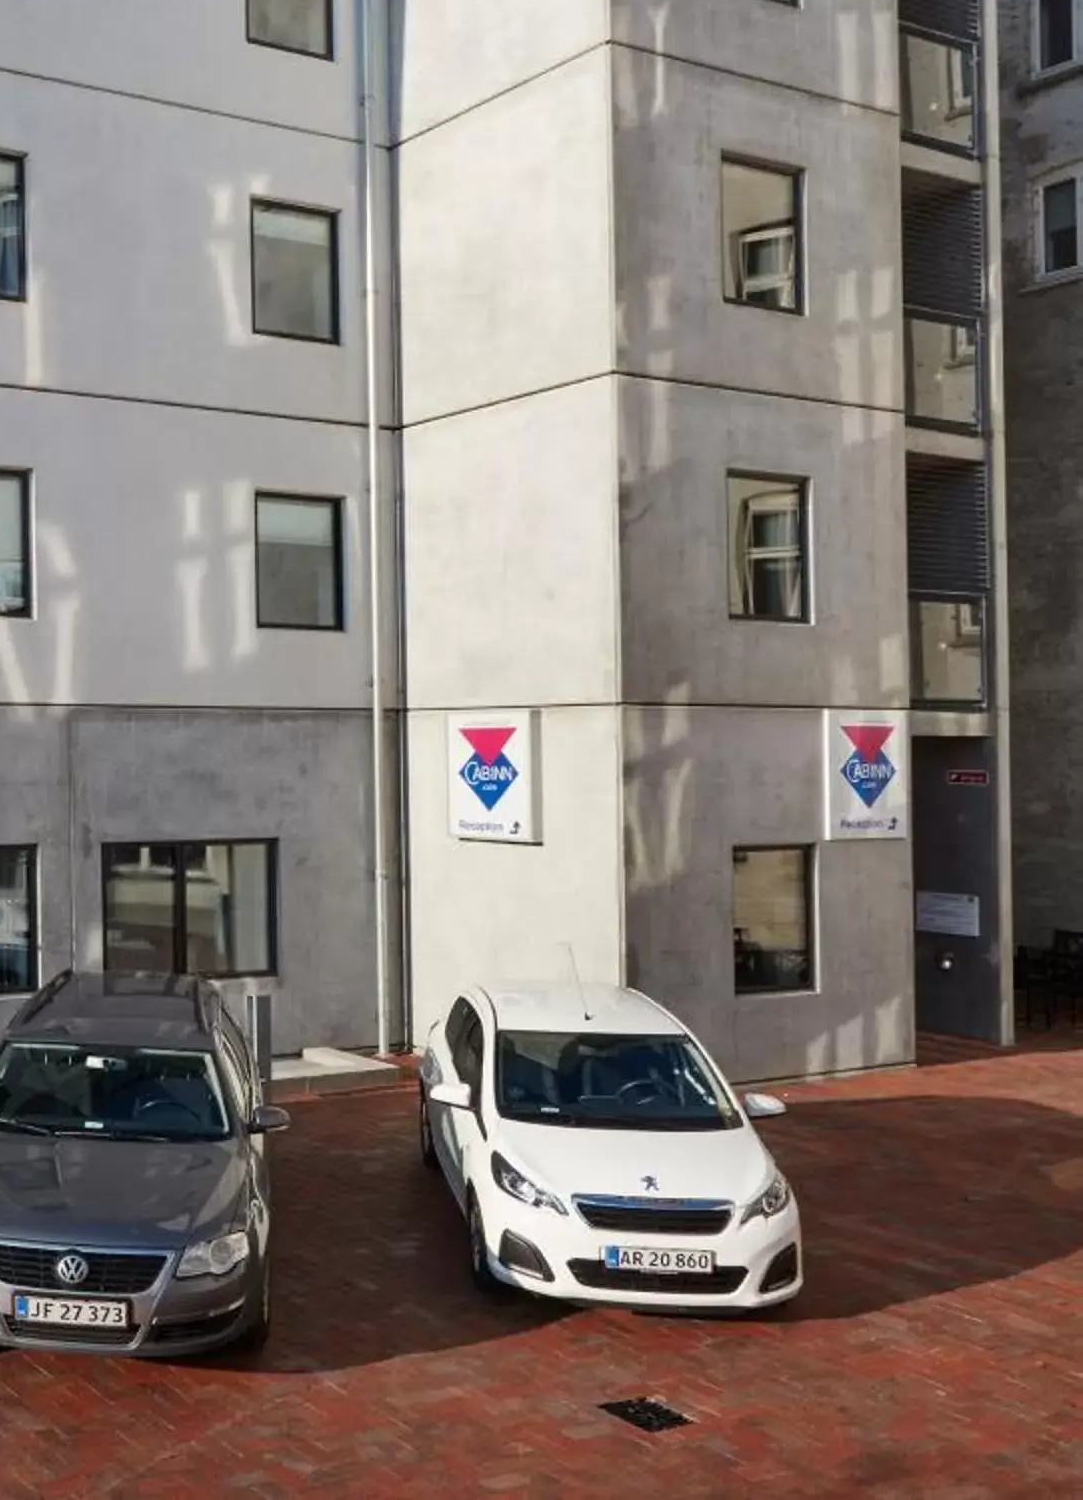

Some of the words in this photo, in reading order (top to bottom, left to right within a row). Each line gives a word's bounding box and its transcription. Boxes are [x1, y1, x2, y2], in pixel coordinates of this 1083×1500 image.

[464, 761, 514, 785] CABINN
[846, 759, 893, 782] CABINN
[620, 1251, 644, 1266] AR
[648, 1252, 670, 1267] 20
[675, 1253, 709, 1269] 860
[31, 1301, 54, 1318] JF
[60, 1303, 83, 1321] 27
[88, 1305, 123, 1323] 373
